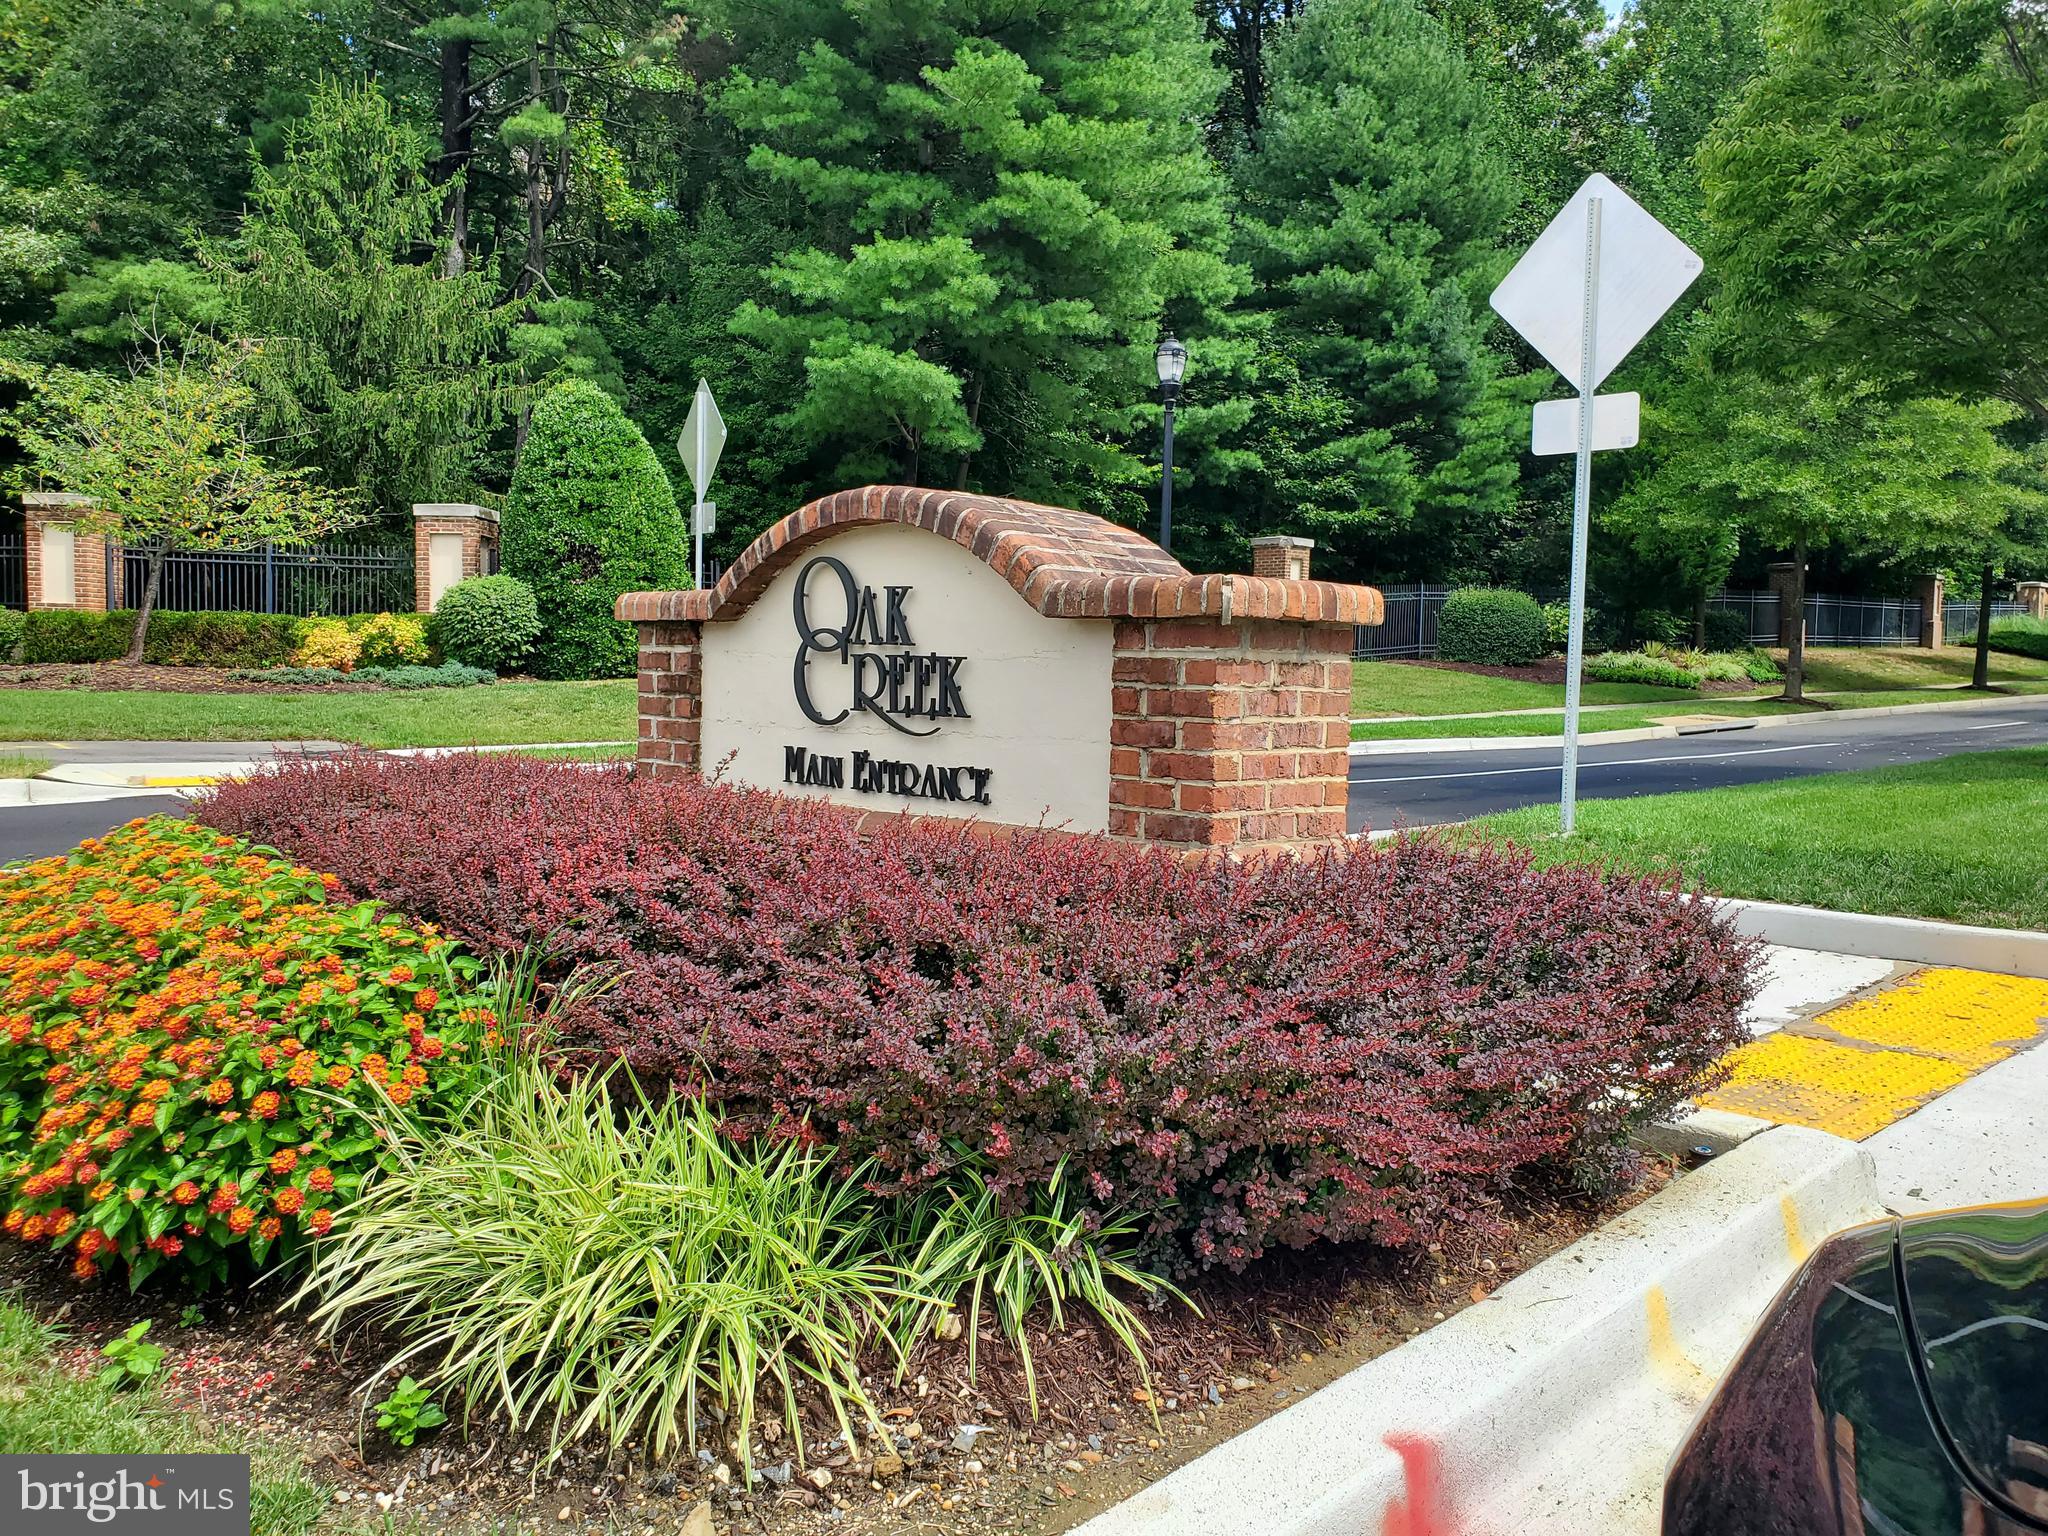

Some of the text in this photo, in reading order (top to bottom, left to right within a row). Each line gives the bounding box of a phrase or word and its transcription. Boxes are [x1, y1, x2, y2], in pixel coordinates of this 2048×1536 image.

[793, 556, 915, 652] OAK
[793, 627, 971, 737] CREEK
[783, 745, 993, 805] MAIN ENTRANCE
